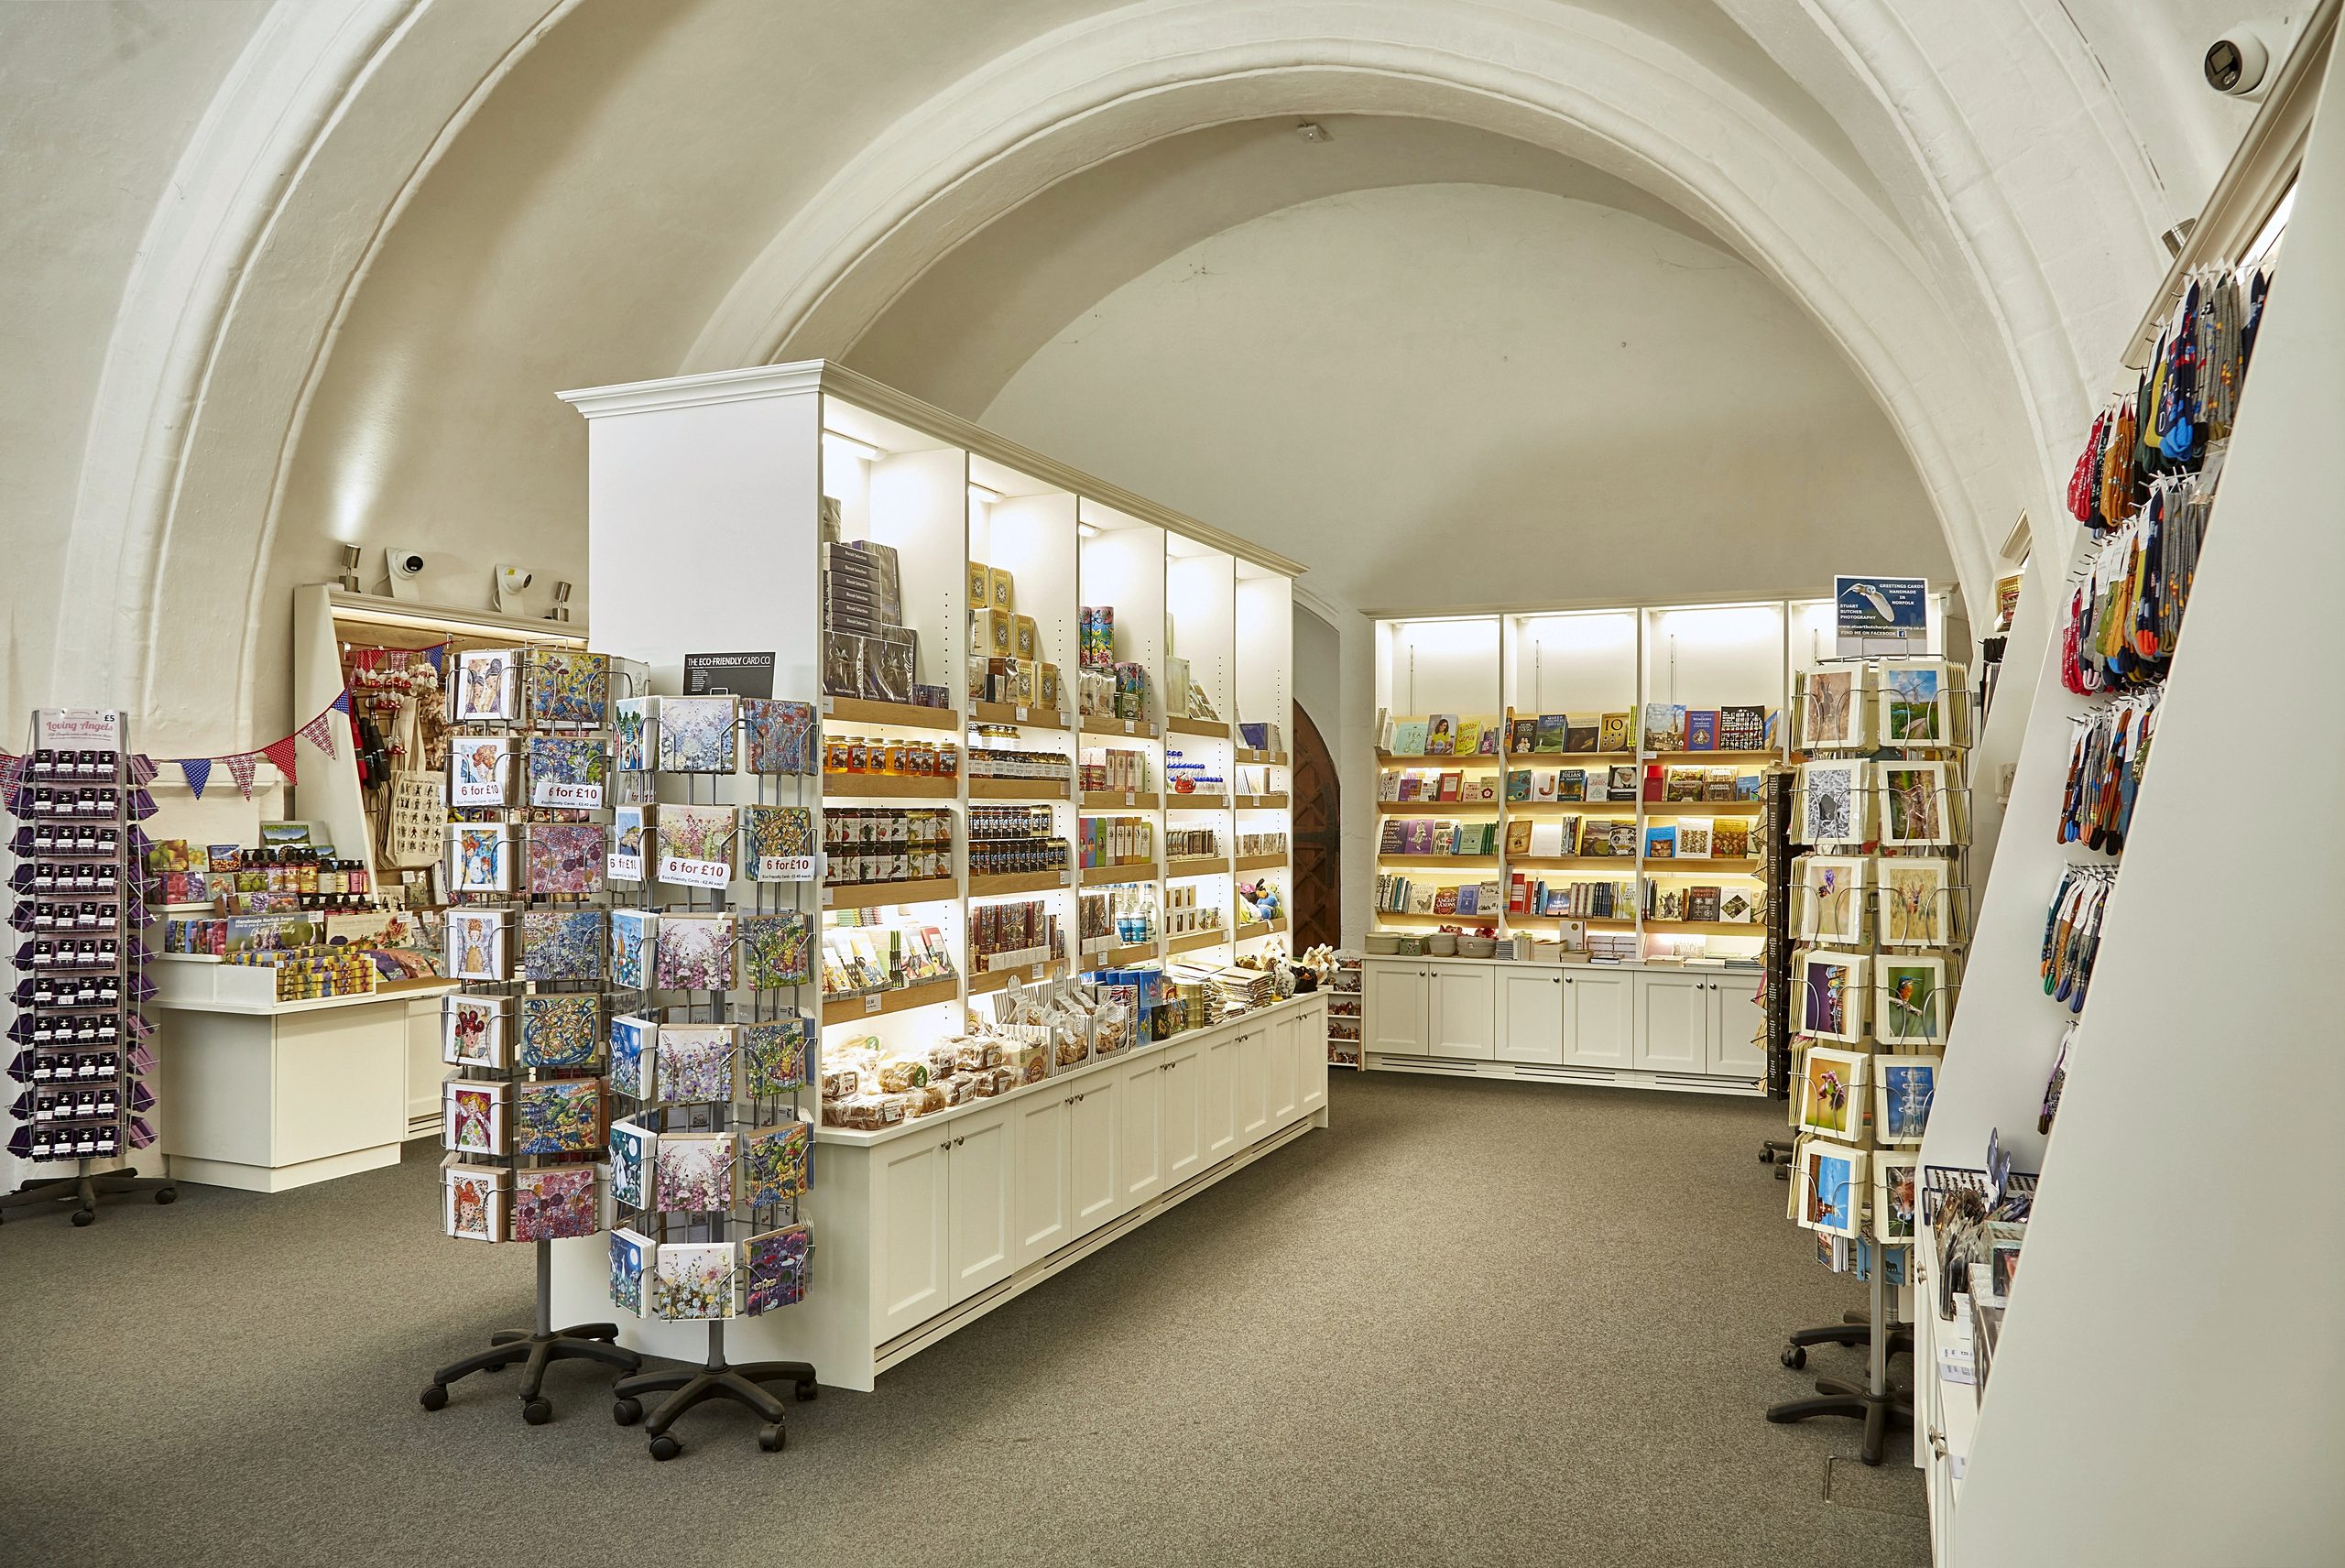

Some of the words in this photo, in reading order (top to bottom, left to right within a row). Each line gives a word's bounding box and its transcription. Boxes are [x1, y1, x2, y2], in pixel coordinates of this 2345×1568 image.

[698, 657, 742, 666] ECO-FRIENDLY
[742, 657, 760, 665] CARD
[47, 721, 77, 731] Loving
[80, 720, 113, 732] Angels
[1606, 719, 1623, 731] 10
[461, 786, 467, 795] 6
[471, 786, 484, 795] for
[486, 784, 499, 794] £10
[549, 787, 554, 796] 6
[556, 787, 573, 797] for
[576, 788, 597, 799] £10
[610, 859, 615, 868] 6
[670, 861, 677, 871] 6
[681, 862, 698, 873] for
[701, 865, 723, 877] £10
[767, 860, 772, 869] 6
[776, 860, 789, 869] for
[790, 860, 808, 869] £10
